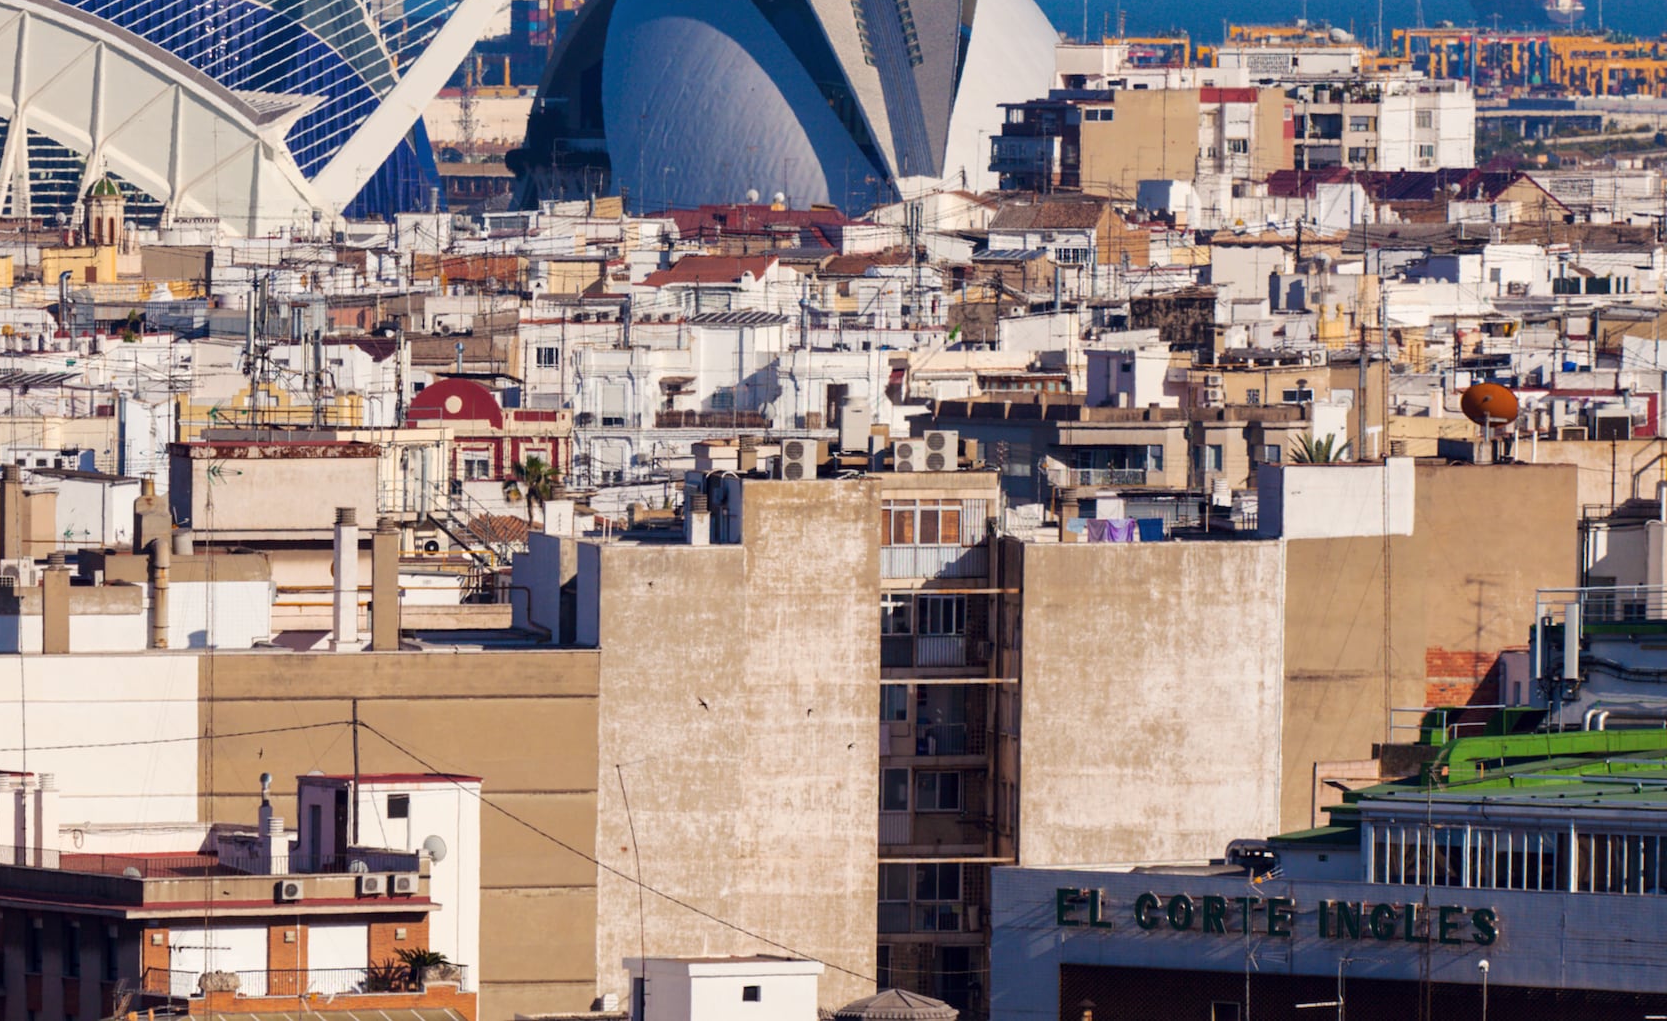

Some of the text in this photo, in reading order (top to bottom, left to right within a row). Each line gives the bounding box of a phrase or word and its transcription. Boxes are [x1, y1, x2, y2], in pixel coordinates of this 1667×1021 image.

[1056, 887, 1500, 946] EL CORTE INGLES
